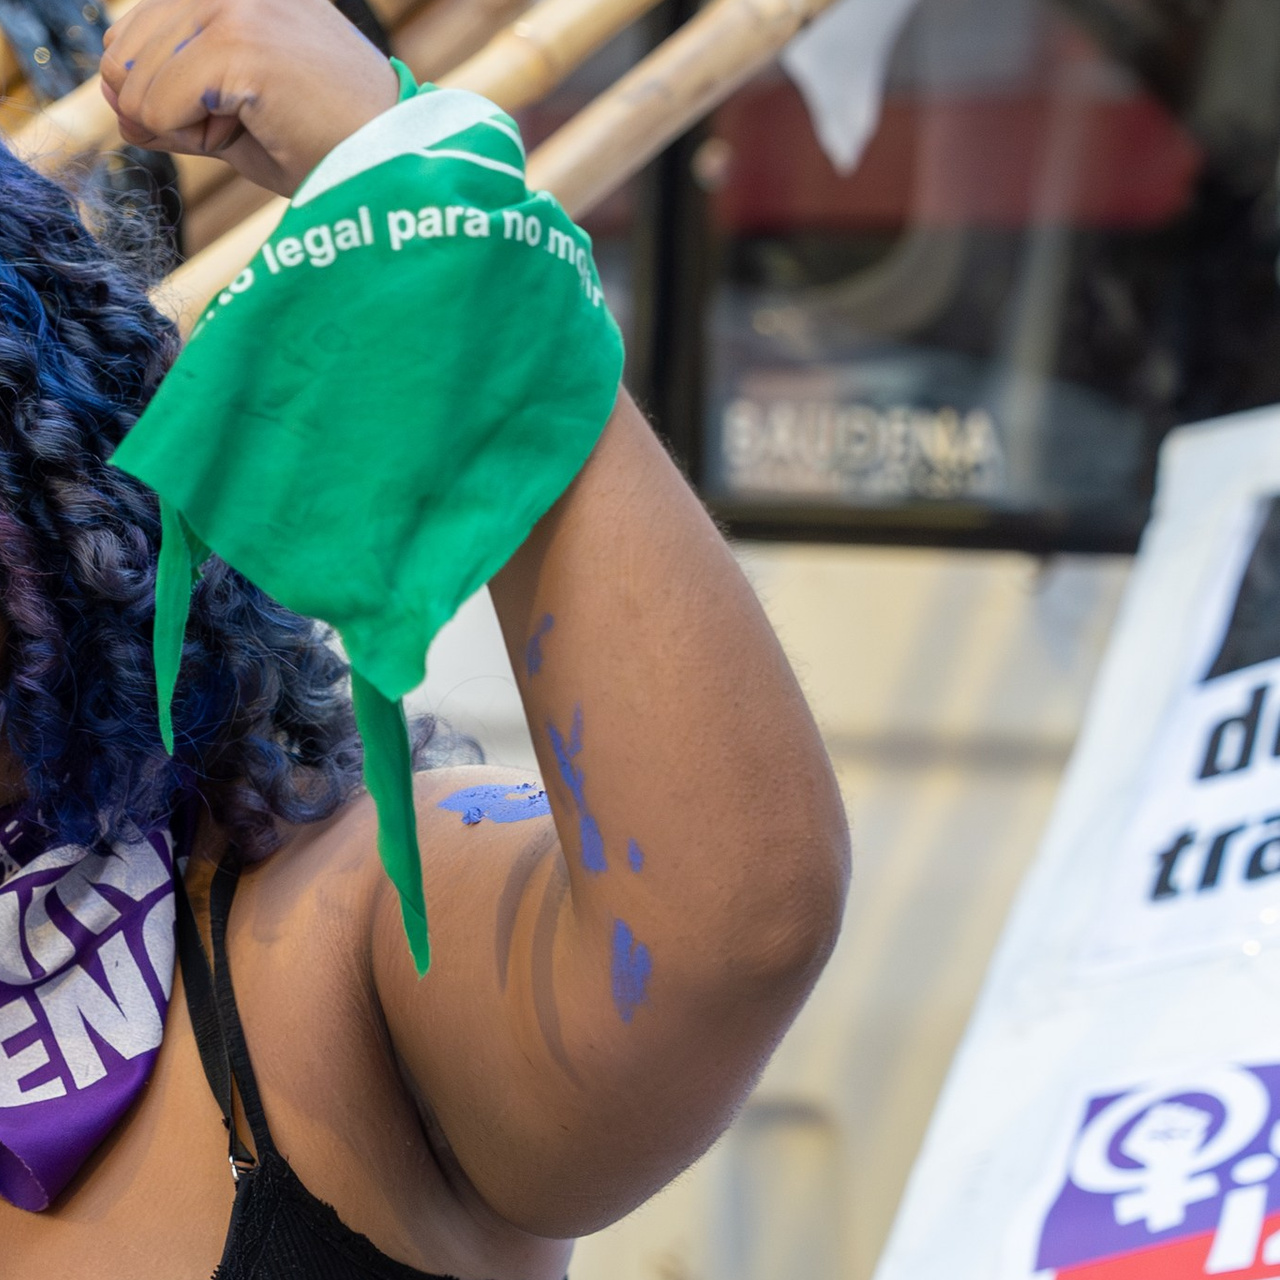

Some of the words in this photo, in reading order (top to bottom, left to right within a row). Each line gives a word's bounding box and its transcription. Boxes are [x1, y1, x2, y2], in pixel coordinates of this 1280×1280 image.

[261, 206, 374, 275] legal
[387, 206, 490, 250] para
[502, 209, 542, 247] no
